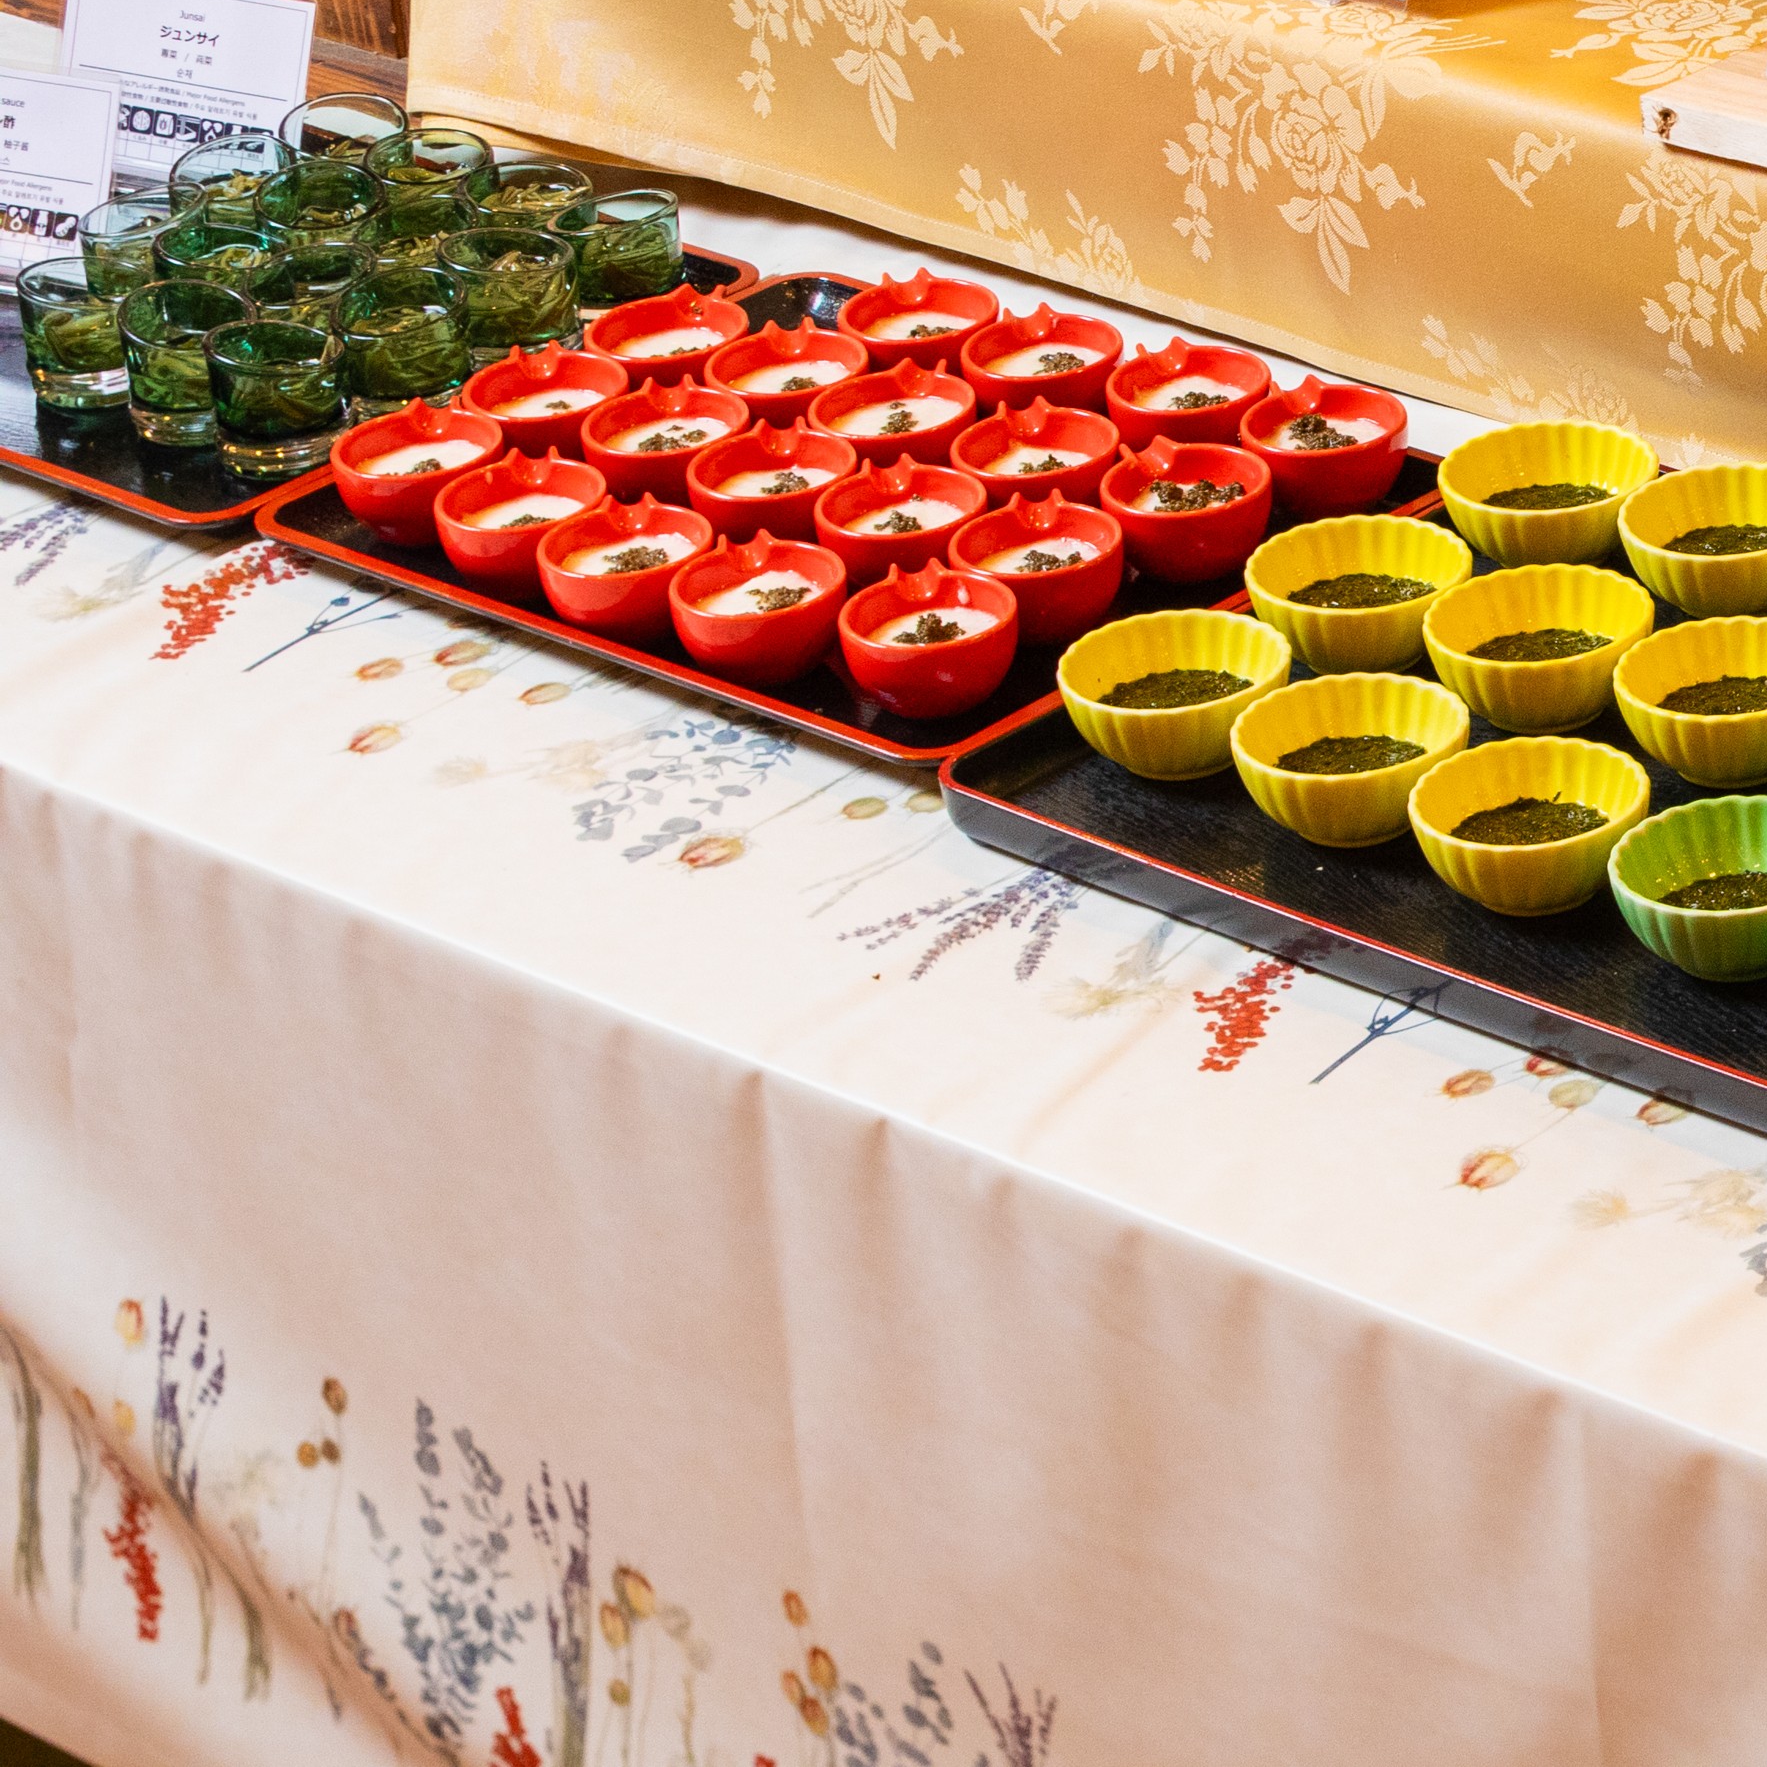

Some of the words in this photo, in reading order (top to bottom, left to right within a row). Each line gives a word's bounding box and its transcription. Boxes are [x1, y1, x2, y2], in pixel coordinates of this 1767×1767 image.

[179, 10, 205, 22] Junsai
[160, 25, 219, 46] ジュンサイ
